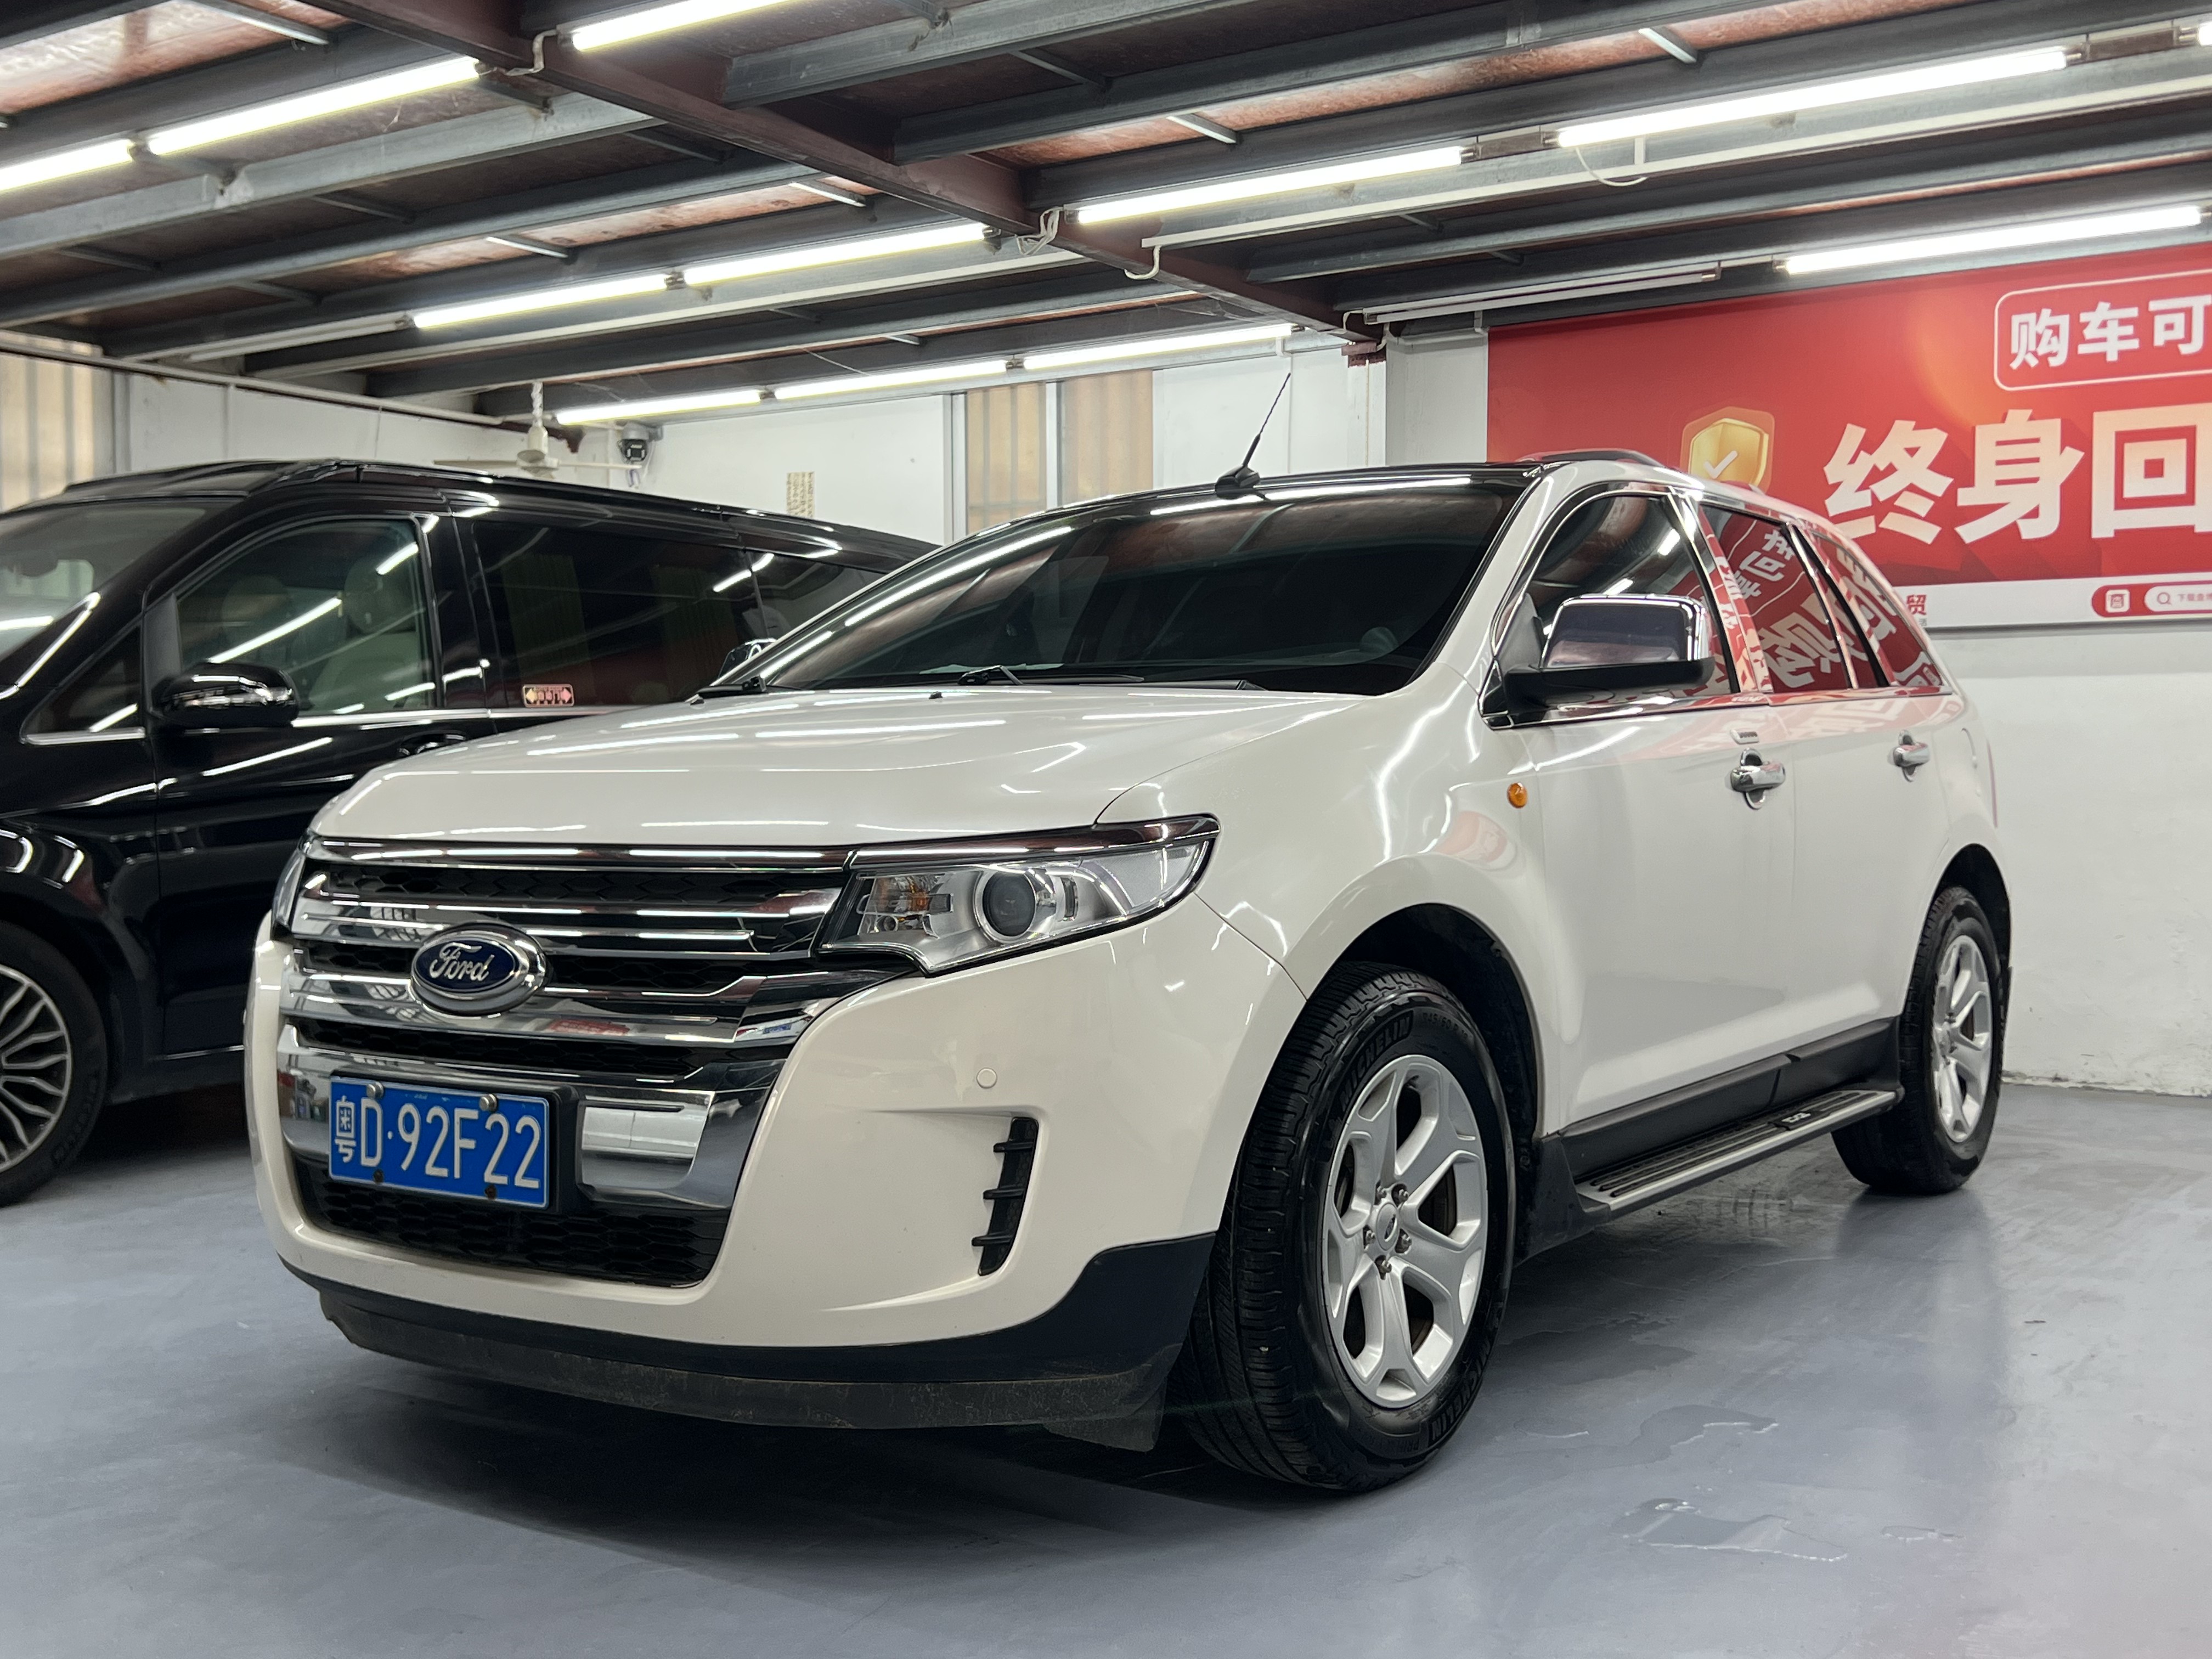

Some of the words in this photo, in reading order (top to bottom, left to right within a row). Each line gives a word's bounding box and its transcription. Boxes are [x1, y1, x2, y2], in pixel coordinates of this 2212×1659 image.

[2009, 294, 2212, 370] 购车可
[1822, 403, 2212, 545] 终身回
[429, 942, 495, 982] Ford
[1339, 1017, 1410, 1112] MICHELIN
[335, 1096, 542, 1189] 粤D·92F22
[1431, 1336, 1491, 1441] MICHELIN
